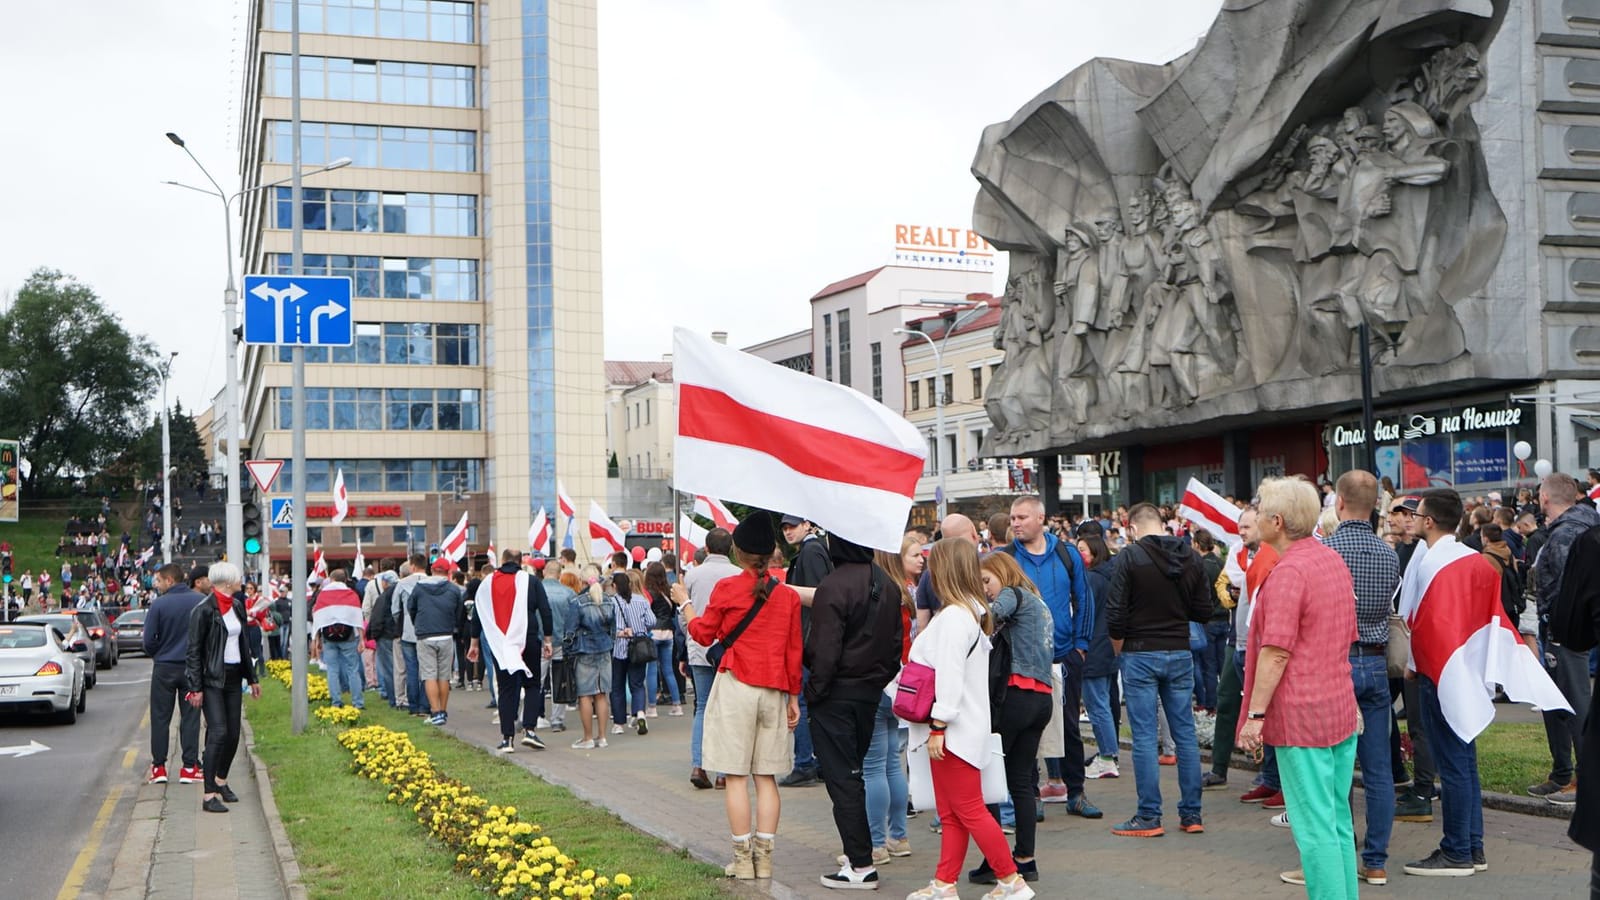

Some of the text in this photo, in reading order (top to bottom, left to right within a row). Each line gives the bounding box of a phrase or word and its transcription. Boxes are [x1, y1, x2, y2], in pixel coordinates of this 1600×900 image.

[895, 224, 960, 248] REALT
[1334, 407, 1522, 446] Столвая на Немиге
[366, 504, 401, 517] KING
[636, 522, 674, 533] BURG
